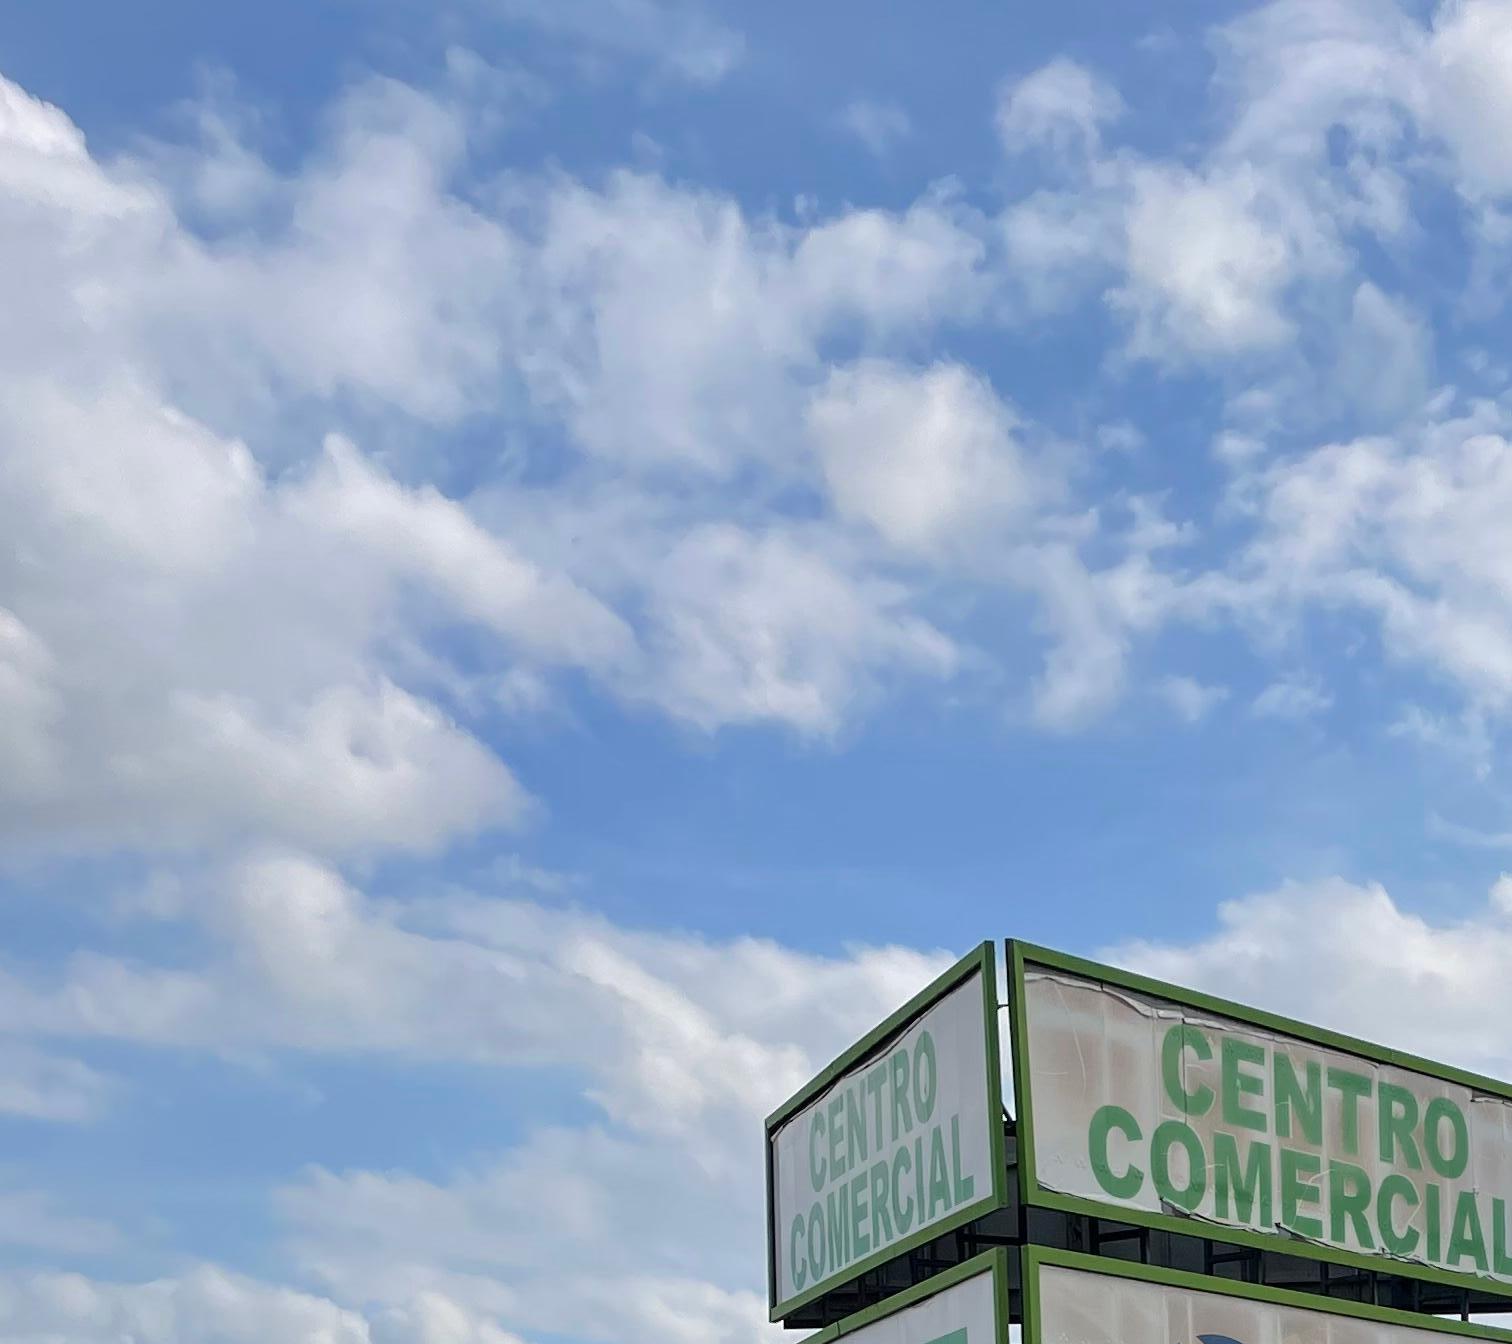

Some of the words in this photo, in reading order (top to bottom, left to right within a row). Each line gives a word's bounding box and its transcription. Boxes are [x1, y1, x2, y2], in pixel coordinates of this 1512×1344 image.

[809, 1029, 937, 1193] CENTRO
[1161, 1024, 1469, 1180] CENTRO
[790, 1115, 974, 1291] COMERCIAL
